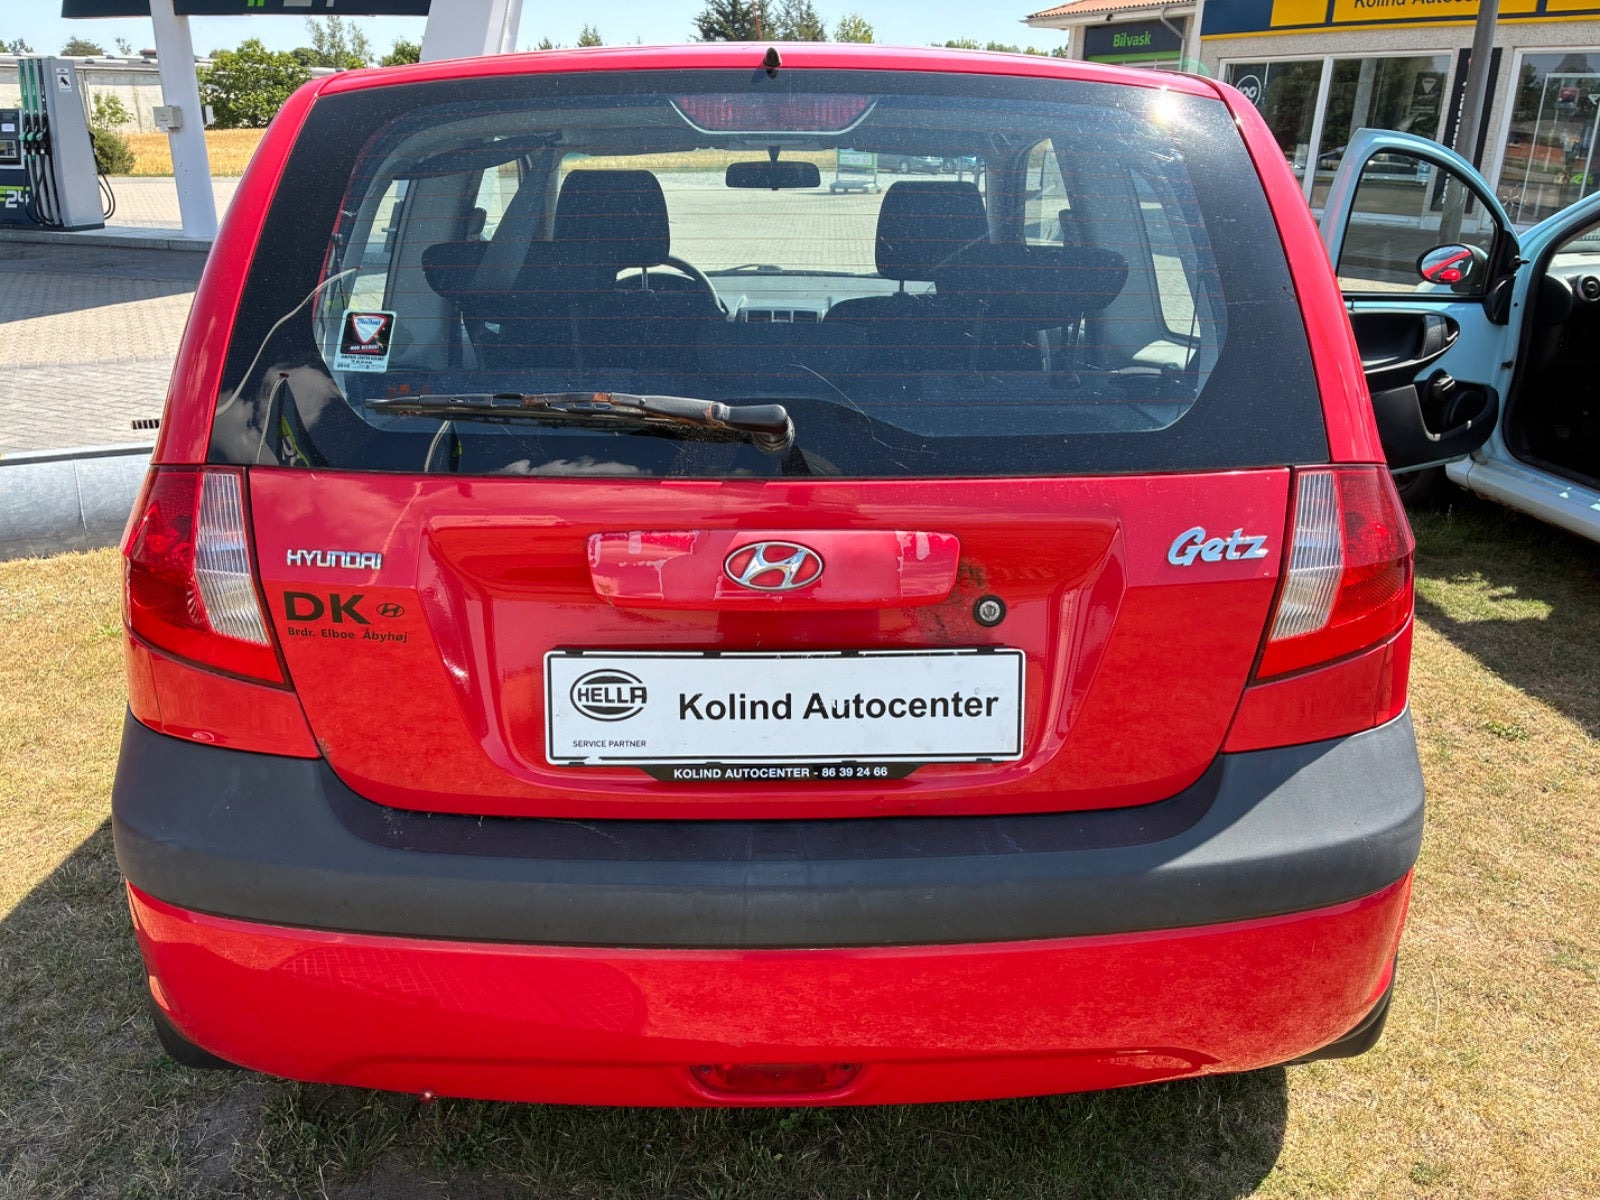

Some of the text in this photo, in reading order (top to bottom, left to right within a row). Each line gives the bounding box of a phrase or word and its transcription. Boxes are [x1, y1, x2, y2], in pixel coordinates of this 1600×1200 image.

[1112, 31, 1151, 47] Bilvask
[1168, 526, 1269, 566] Getz
[286, 549, 382, 570] HYUNDAI
[283, 591, 371, 625] DK
[288, 627, 408, 643] Brdr. Elboe Åbyhøj
[577, 687, 648, 704] HELLA
[679, 691, 999, 721] Kolind Autocenter
[572, 740, 647, 748] SERVICE PARTNER
[673, 768, 722, 779] KOLIND
[725, 767, 811, 779] AUTOCENTER
[821, 767, 836, 778] 86
[839, 767, 854, 777] 39
[856, 766, 871, 777] 24
[873, 766, 888, 777] 66
